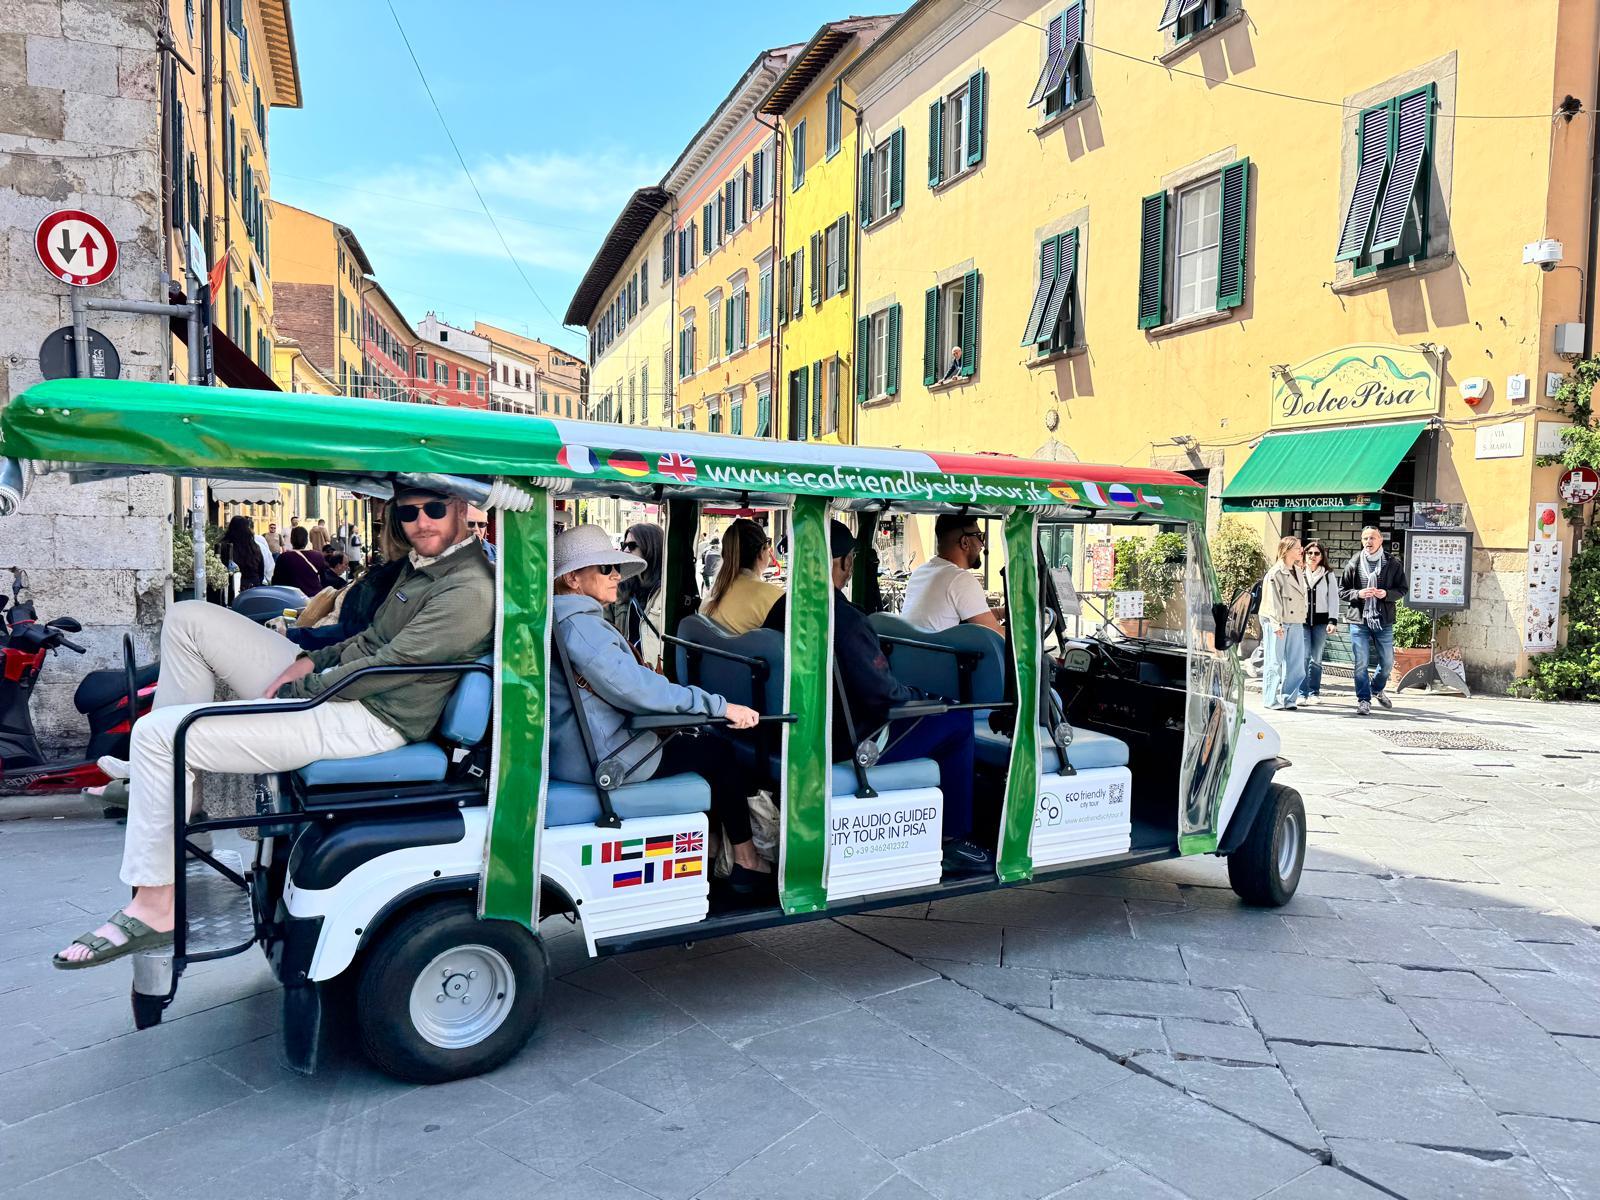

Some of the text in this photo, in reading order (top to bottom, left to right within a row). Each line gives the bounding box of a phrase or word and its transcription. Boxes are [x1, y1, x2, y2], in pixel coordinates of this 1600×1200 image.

[1282, 381, 1423, 417] Dolce Pisa
[1490, 442, 1512, 450] MARIA
[704, 464, 1048, 502] www.ecofriendlycitytour.it
[1284, 497, 1344, 507] PASTICCERIA
[6, 773, 48, 786] aprilia
[1080, 788, 1107, 800] friendly
[832, 807, 936, 831] UR AUDIO GUIDED
[853, 828, 885, 843] TOUR
[889, 826, 900, 839] IN
[903, 822, 927, 836] PISA
[856, 841, 909, 855] +39 3462412322
